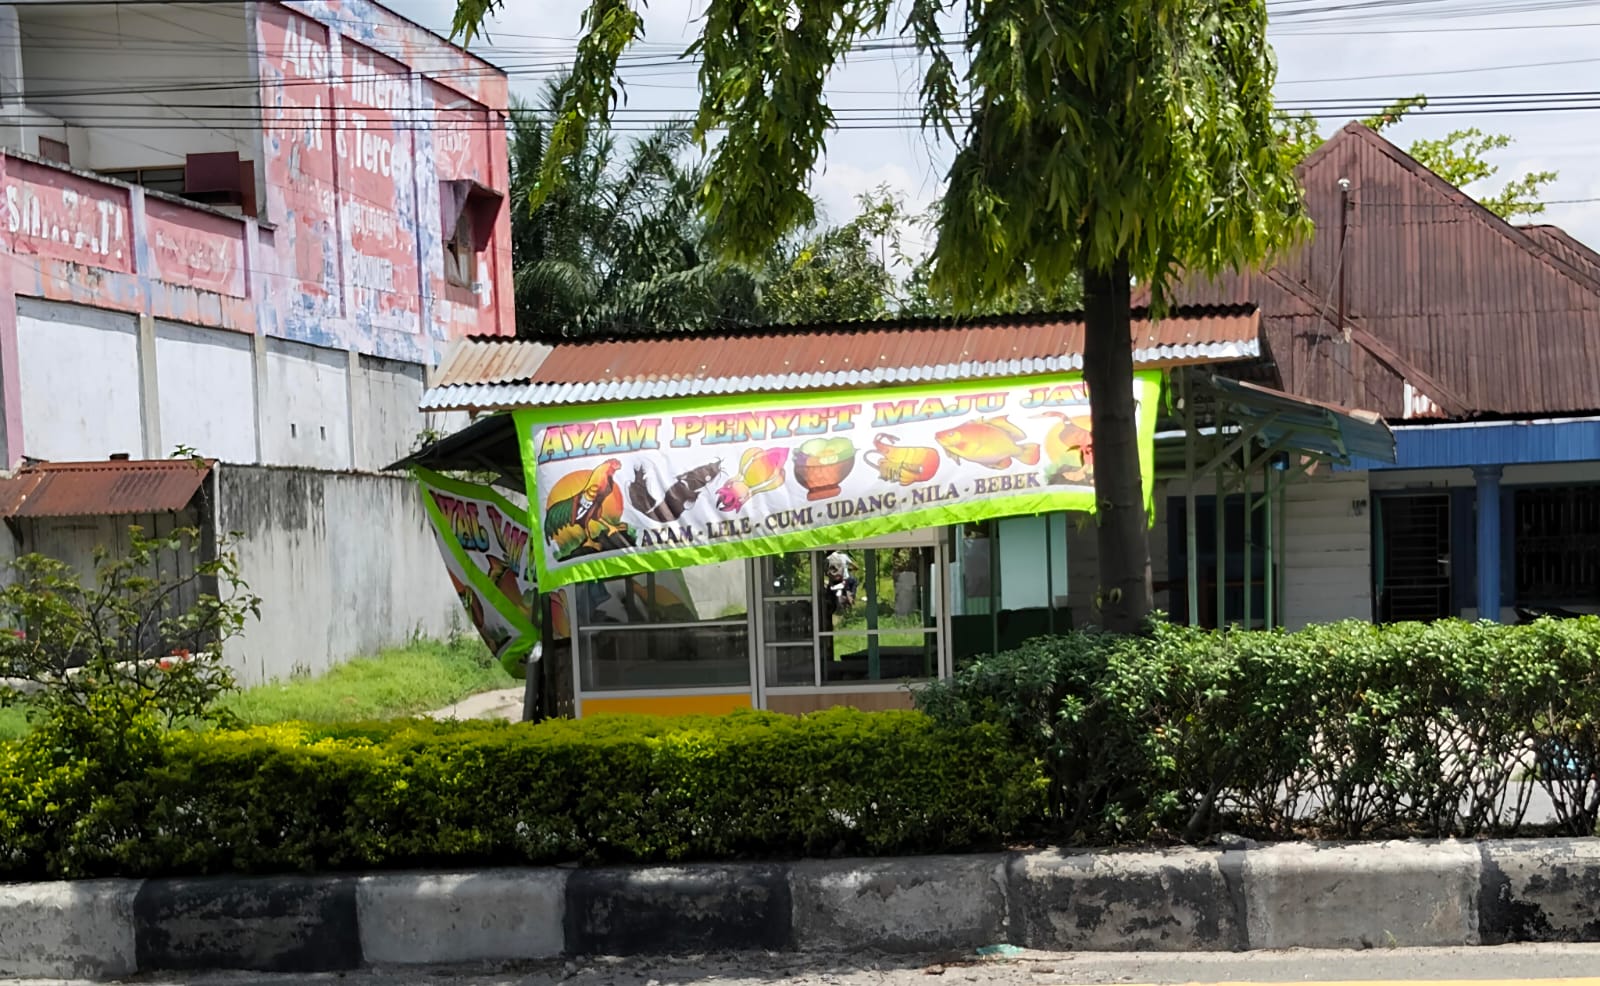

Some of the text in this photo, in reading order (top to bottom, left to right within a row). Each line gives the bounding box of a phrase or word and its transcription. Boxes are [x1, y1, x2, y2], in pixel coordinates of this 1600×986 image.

[538, 383, 1090, 465] AYAM PENYET MAJU JAY
[641, 525, 694, 547] AYAM
[706, 517, 751, 539] LELE
[765, 507, 814, 531] CUMI
[826, 492, 896, 520] UDANG
[911, 481, 959, 506] NILA
[974, 471, 1041, 495] BEBEK
